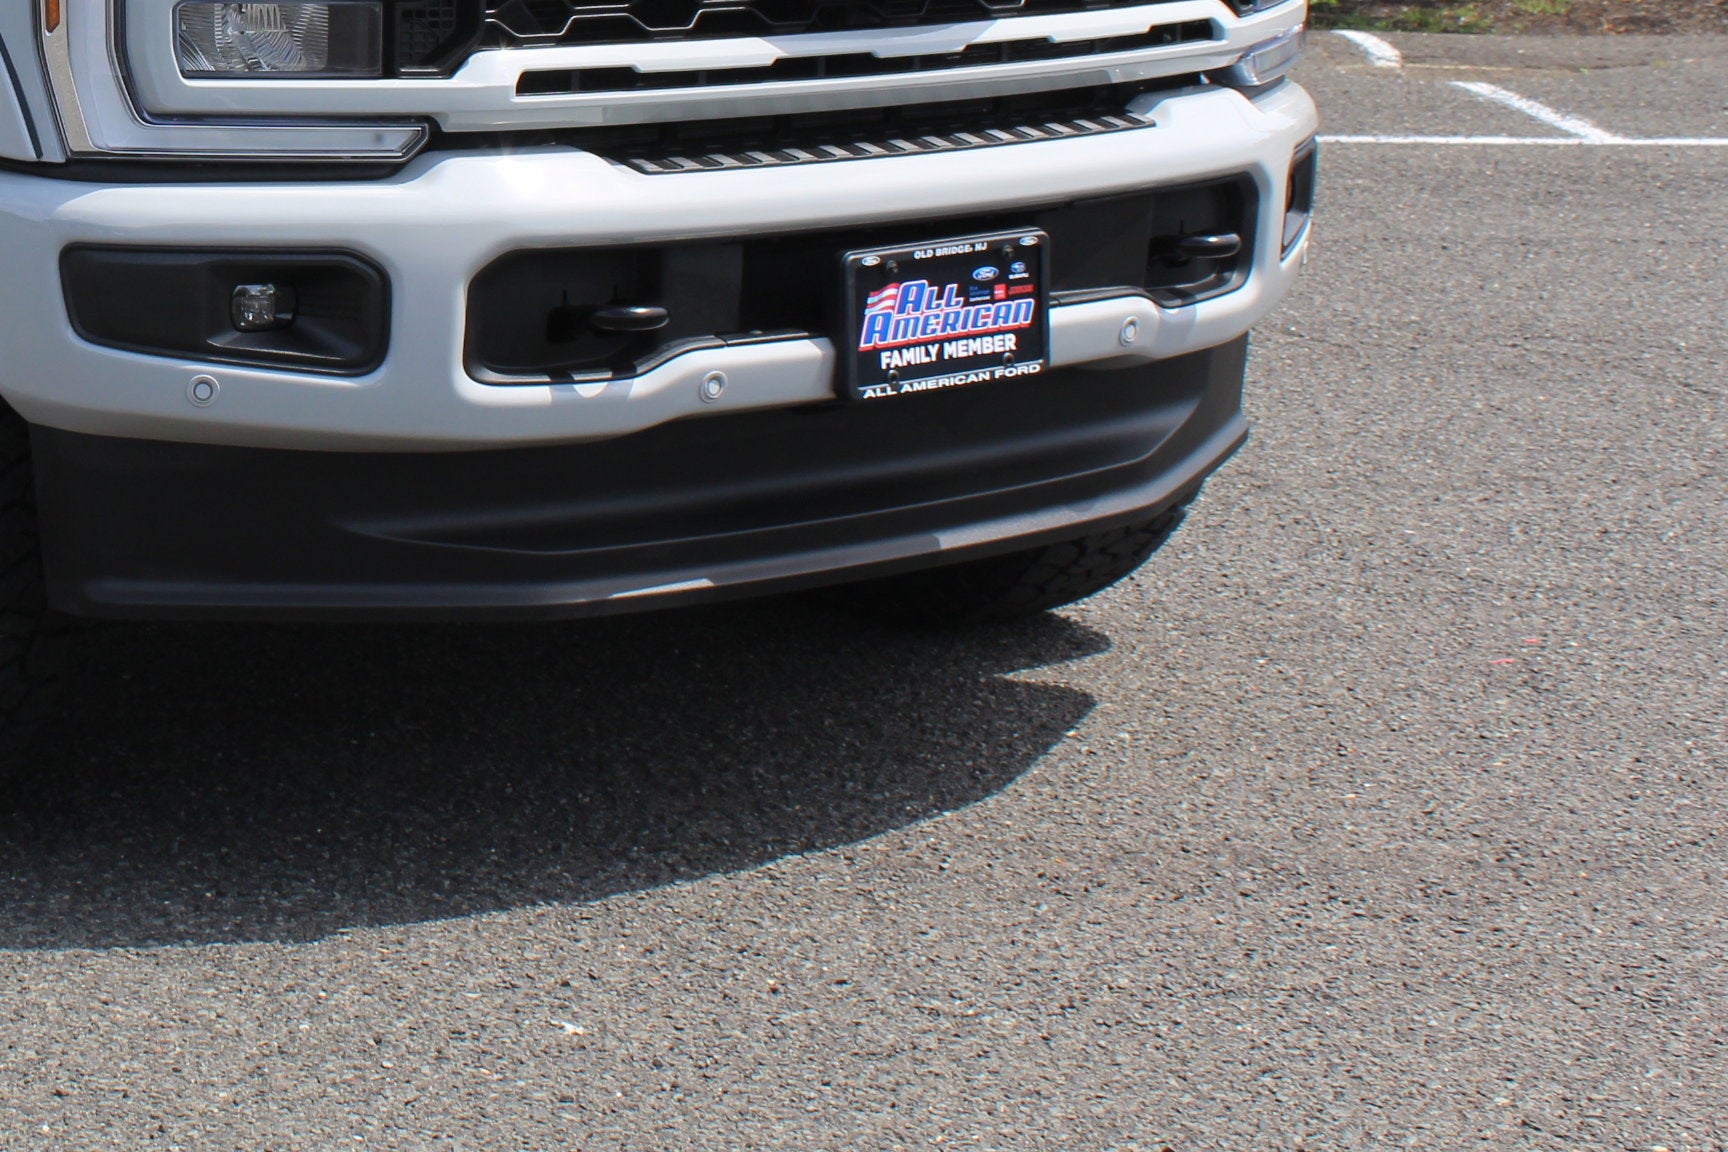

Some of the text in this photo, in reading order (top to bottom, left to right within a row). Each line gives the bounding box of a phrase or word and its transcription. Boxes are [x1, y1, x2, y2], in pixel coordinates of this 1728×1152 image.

[913, 249, 934, 260] OLD
[974, 242, 988, 252] NJ
[880, 333, 1017, 370] FAMILY MEMBER
[863, 362, 1042, 399] ALL AMERICAN FORD
